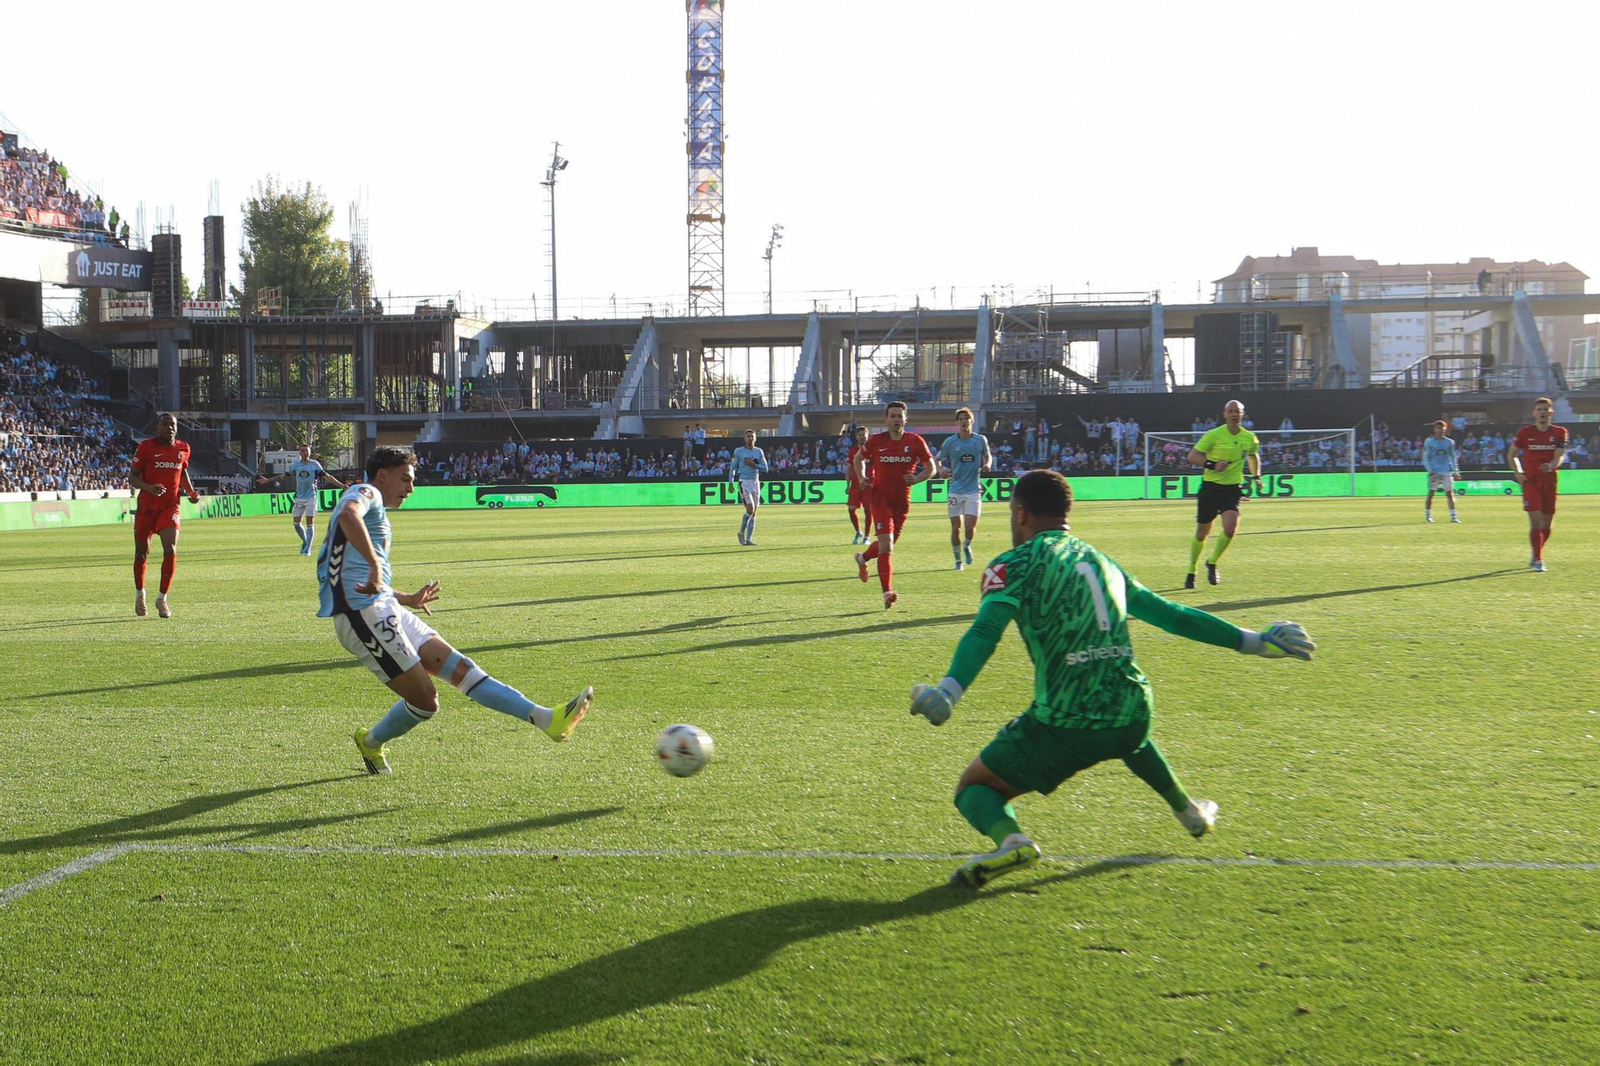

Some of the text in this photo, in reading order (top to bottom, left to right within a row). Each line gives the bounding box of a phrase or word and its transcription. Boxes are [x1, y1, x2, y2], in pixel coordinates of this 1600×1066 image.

[697, 30, 716, 160] COPASA
[93, 261, 142, 278] JUST EAT
[1075, 561, 1111, 631] 1
